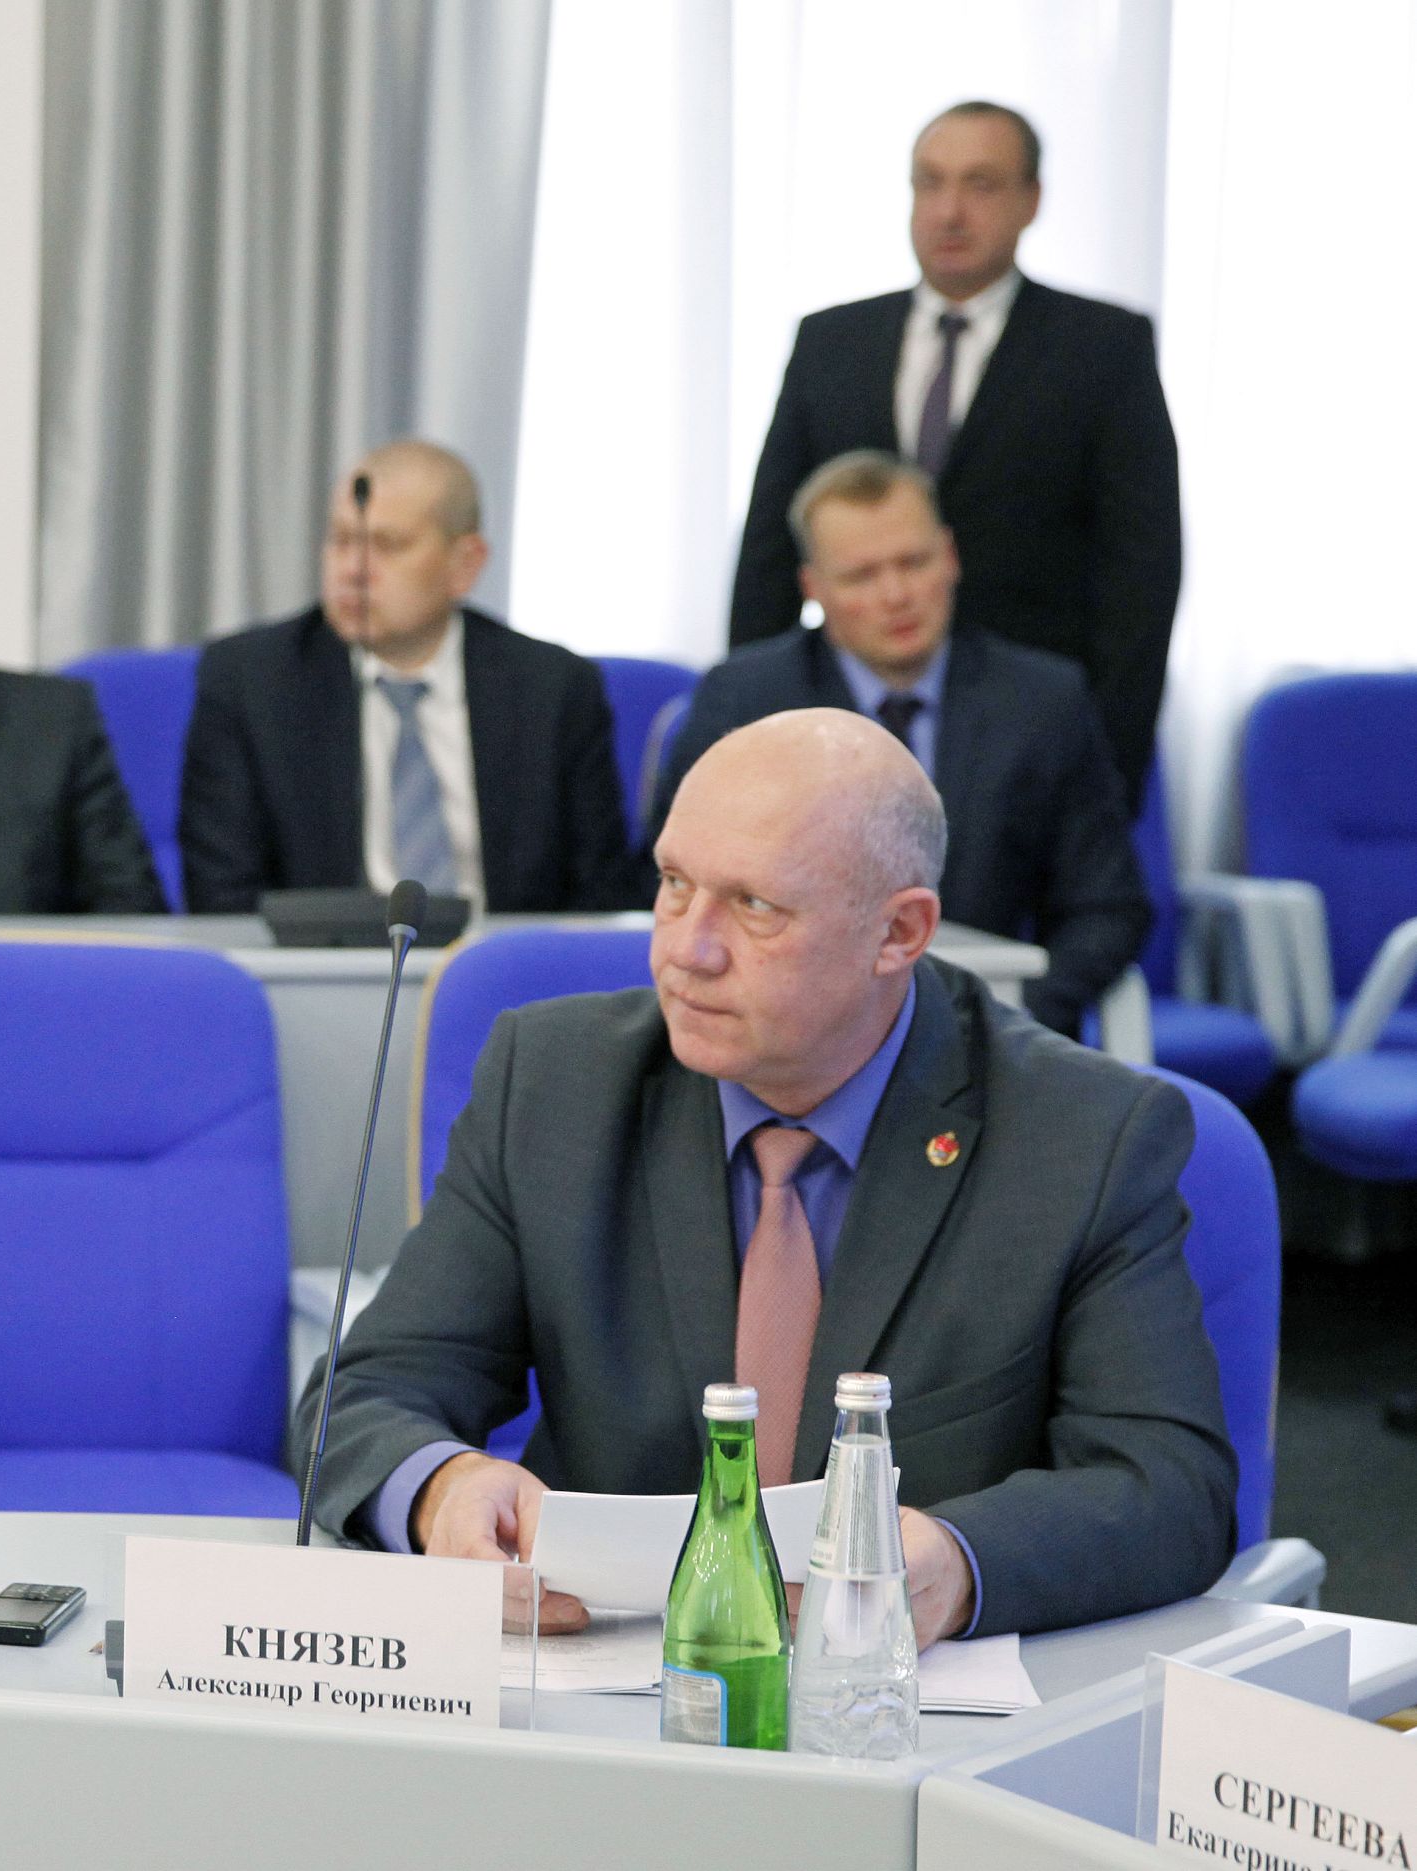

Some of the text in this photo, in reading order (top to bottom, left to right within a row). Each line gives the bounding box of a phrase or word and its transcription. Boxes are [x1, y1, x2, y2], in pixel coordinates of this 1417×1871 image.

[222, 1624, 407, 1670] КНЯЗЕВ
[157, 1668, 472, 1716] Александр Георгиевич
[1214, 1772, 1411, 1870] СЕРГЕЕВА
